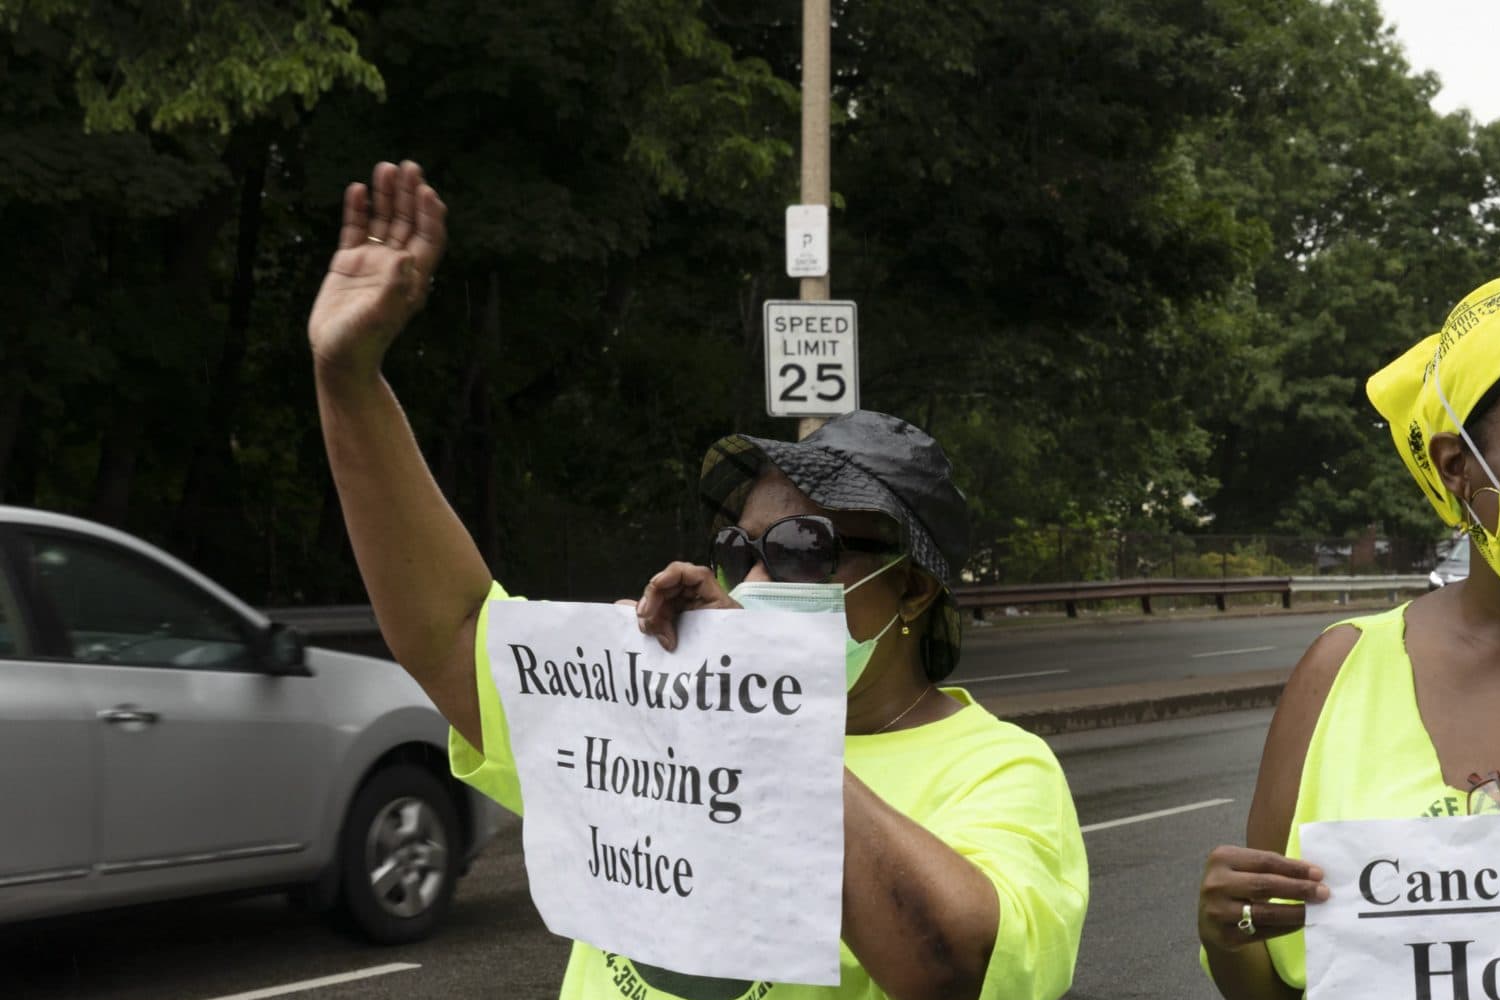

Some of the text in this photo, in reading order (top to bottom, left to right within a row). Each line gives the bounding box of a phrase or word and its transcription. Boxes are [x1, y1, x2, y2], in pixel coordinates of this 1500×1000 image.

[775, 316, 848, 334] SPEED
[783, 339, 839, 356] LIMIT
[779, 363, 846, 402] 25
[508, 643, 803, 716] Racial Justice
[584, 736, 742, 824] Housing
[588, 825, 694, 898] Justice
